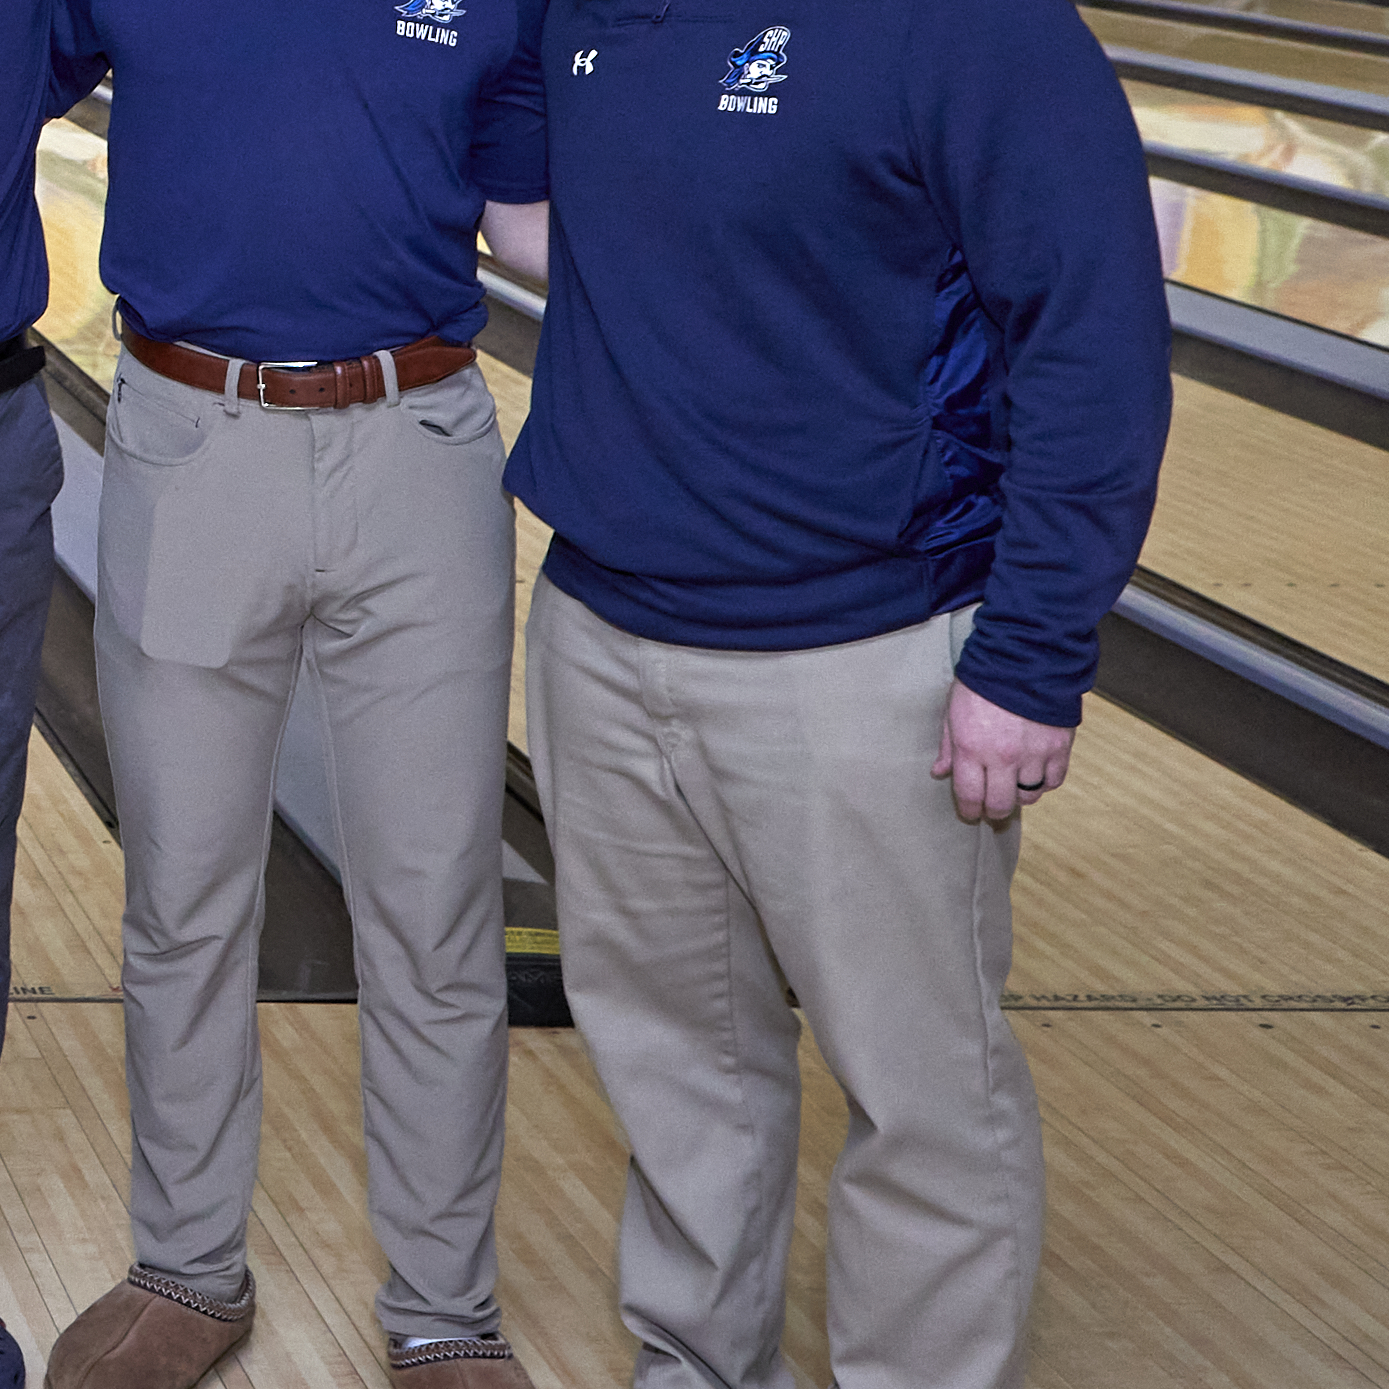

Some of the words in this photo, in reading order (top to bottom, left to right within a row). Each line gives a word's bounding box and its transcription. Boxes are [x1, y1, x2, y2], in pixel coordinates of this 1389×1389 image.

[396, 19, 459, 47] BOWLING
[758, 28, 788, 52] SHP
[717, 94, 779, 115] BOWLING
[9, 986, 56, 995] INE
